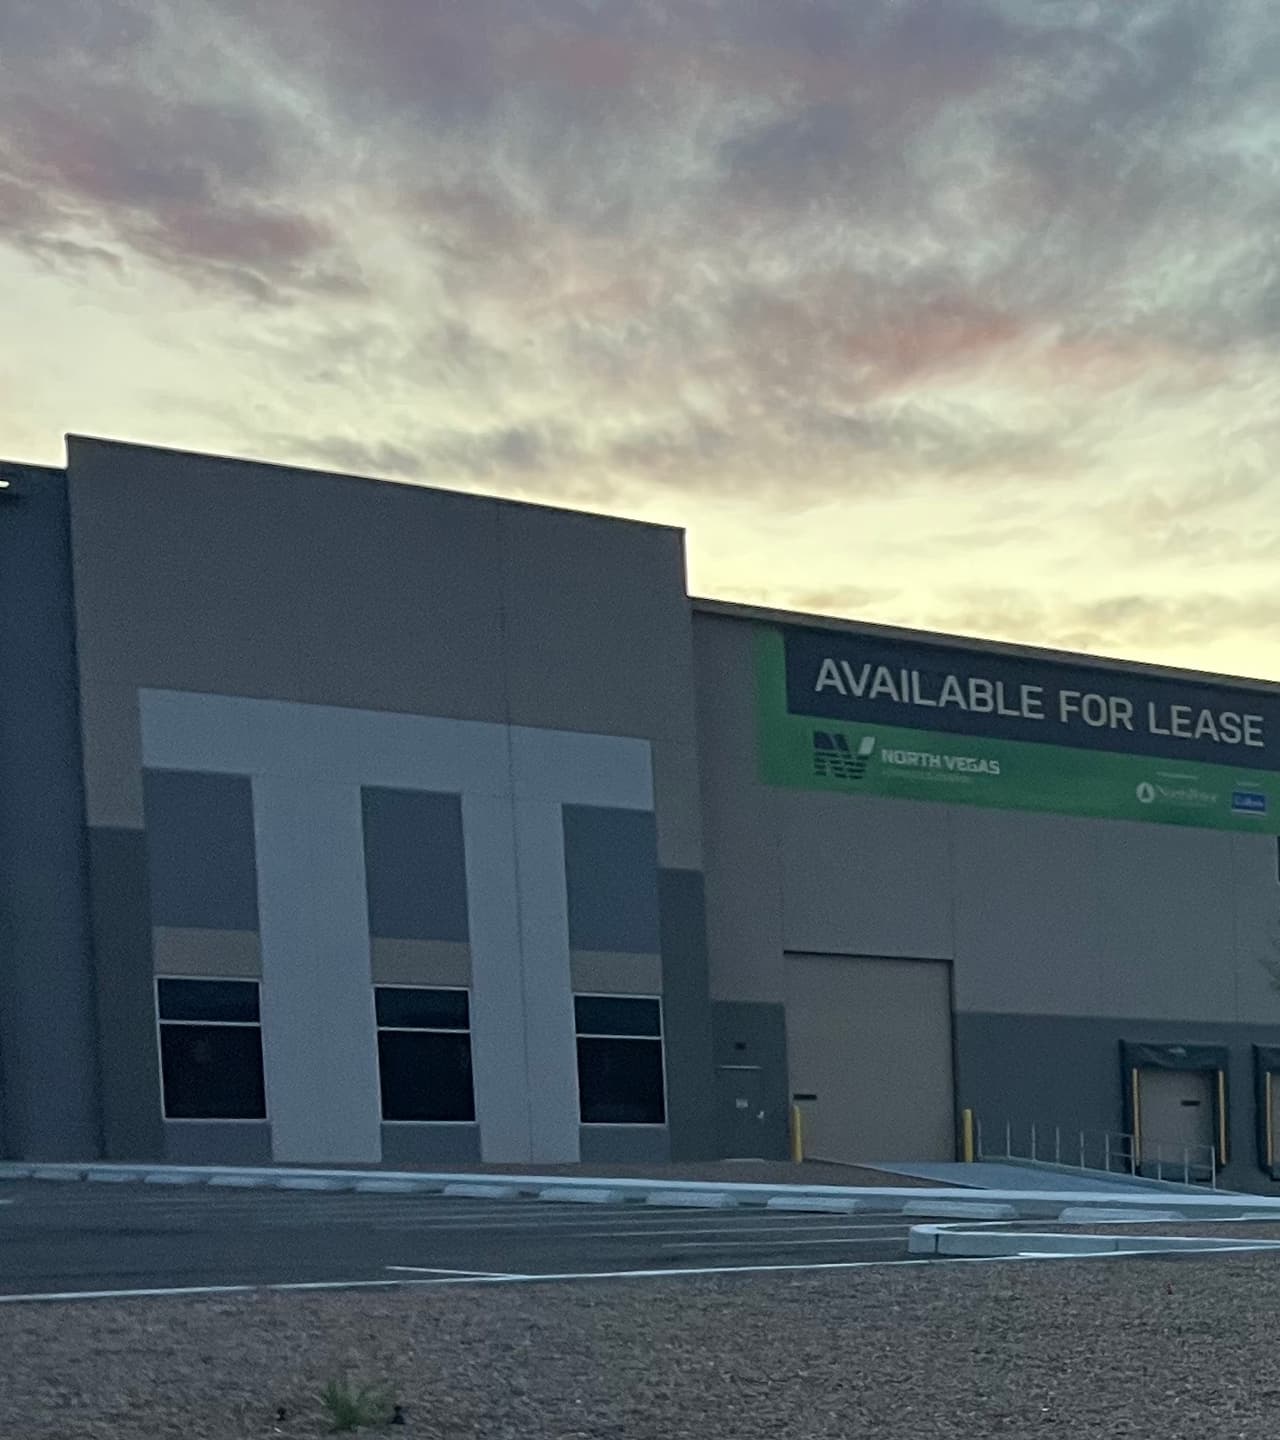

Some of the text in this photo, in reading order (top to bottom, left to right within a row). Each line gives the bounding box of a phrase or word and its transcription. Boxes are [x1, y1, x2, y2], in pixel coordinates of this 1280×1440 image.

[814, 658, 1266, 747] AVAILABLE FOR LEASE
[881, 749, 941, 769] NORTH
[943, 755, 1000, 775] VEGAS
